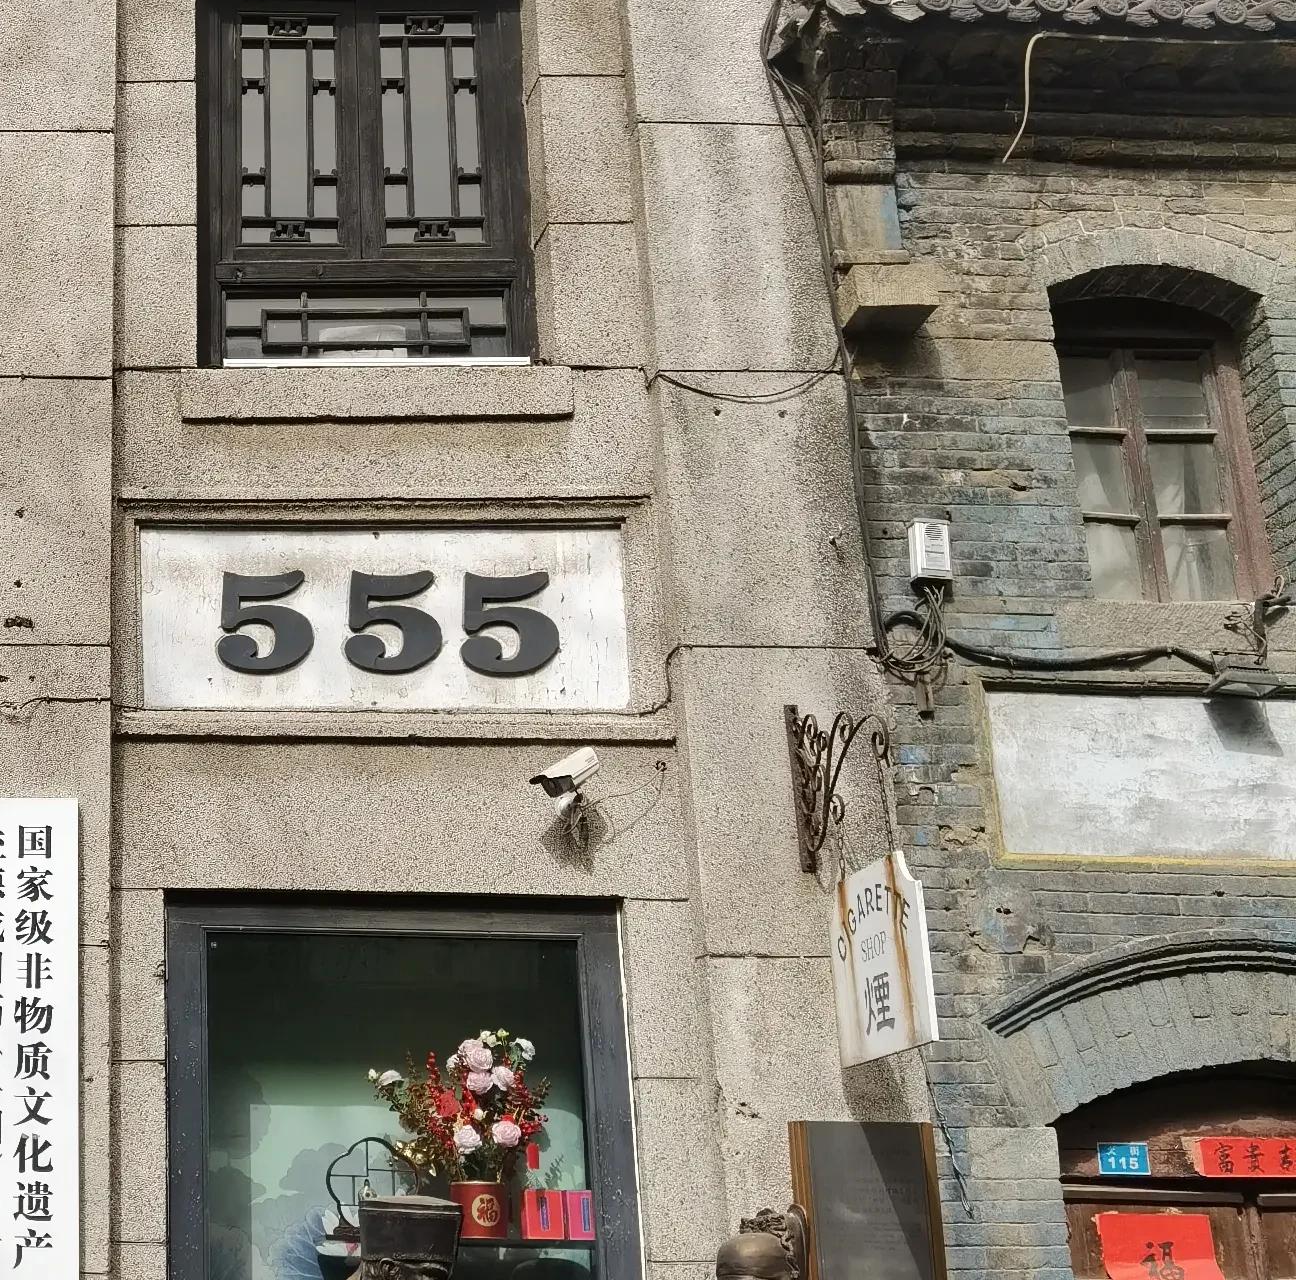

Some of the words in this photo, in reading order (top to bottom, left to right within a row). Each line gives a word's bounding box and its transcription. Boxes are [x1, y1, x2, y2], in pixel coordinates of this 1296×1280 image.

[216, 569, 561, 678] 555
[837, 883, 911, 962] CIGARETTE
[861, 930, 888, 963] SHOP
[864, 971, 895, 1036] 煙
[12, 824, 54, 1269] 国家级非物质文化遗产
[1108, 1156, 1139, 1170] 115
